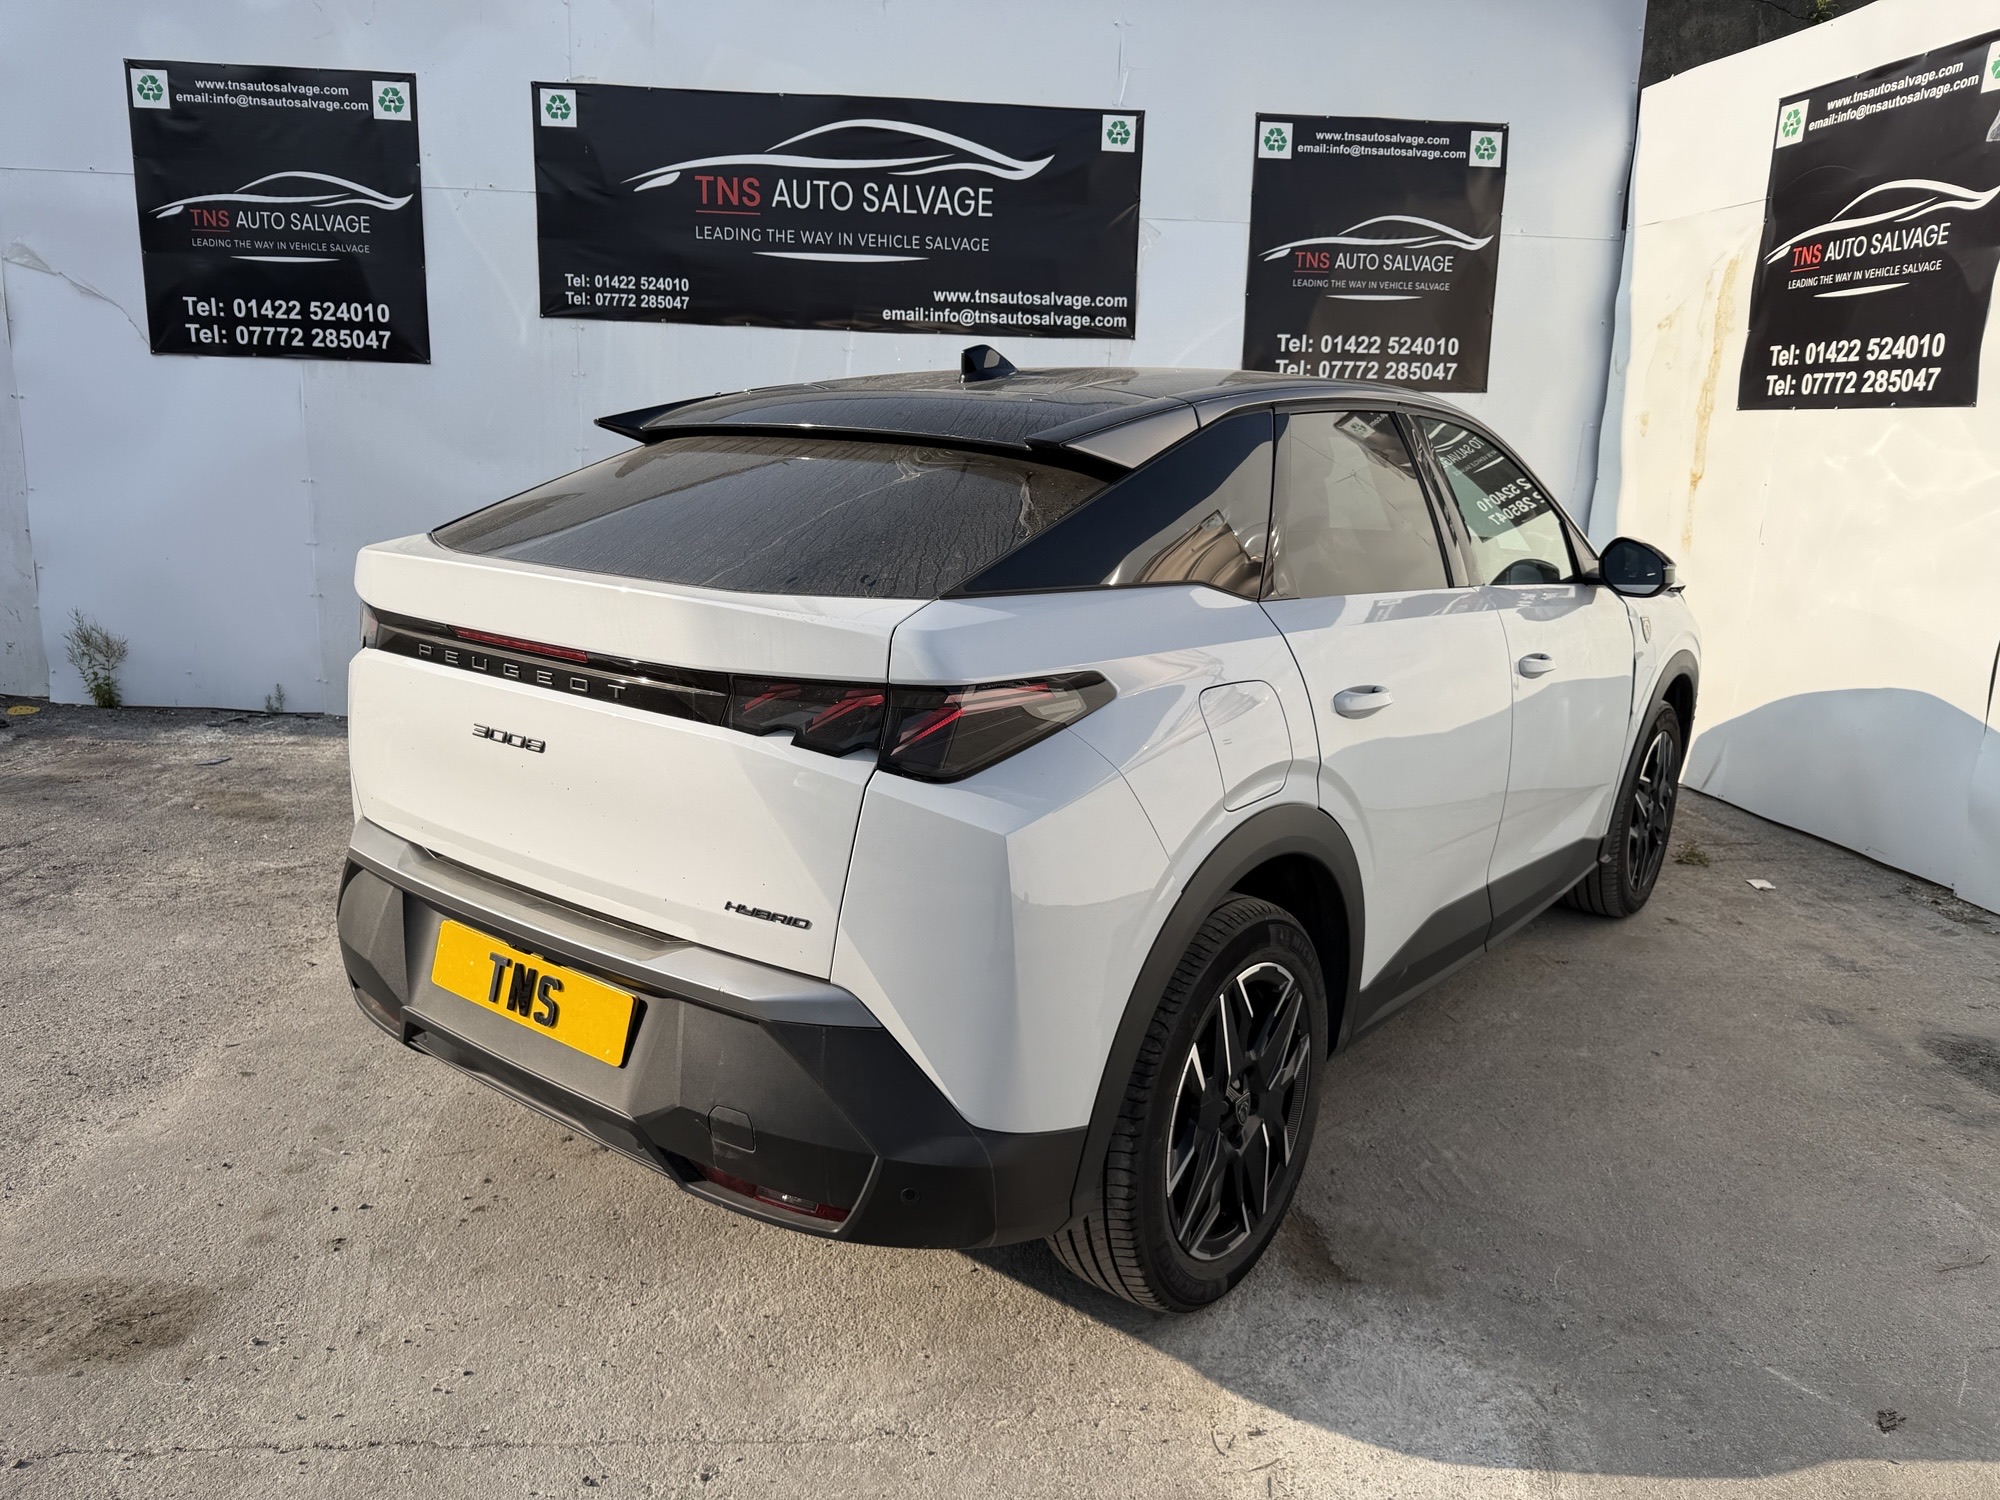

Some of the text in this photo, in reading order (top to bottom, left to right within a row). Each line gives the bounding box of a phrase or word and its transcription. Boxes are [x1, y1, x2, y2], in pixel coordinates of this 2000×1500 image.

[194, 79, 349, 96] www.tnsautosalvage.com
[1827, 61, 1963, 111] www.tnsautosalvage.com
[176, 92, 369, 112] email:info@tnsautosalvage.com
[1808, 73, 1979, 132] email:info@tnsautosalvage.com
[1316, 131, 1450, 145] www.tnsautosalvage.com
[1297, 144, 1466, 159] email:info@tnsautosalvage.com
[694, 174, 994, 218] TNS AUTO SALVAGE
[190, 209, 370, 233] TNS AUTO SALVAGE
[192, 238, 369, 253] LEADING THE WAY IN VEHICLE SALVAGE
[695, 226, 990, 252] LEADING THE WAY IN VEHICLE SALVAGE
[1792, 222, 1951, 267] TNS AUTO SALVAGE
[1295, 252, 1453, 272] TNS AUTO SALVAGE
[565, 272, 690, 292] Tel: 01422 524010
[1293, 279, 1450, 291] LEADING THE WAY IN VEHICLE SALVAGE
[1788, 260, 1942, 290] LEADING THE WAY IN VEHICLE SALVAGE
[183, 296, 389, 323] Tel: 01422 524010
[566, 291, 690, 310] Tel: 07772 285047
[934, 288, 1128, 310] www.tnsautosalvage.com
[882, 306, 1128, 329] email:info@tnsautosalvage.com
[185, 324, 391, 349] Tel: 07772 285047
[1277, 334, 1459, 355] Tel: 01422 524010
[1770, 333, 1946, 366] Tel: 01422 524010
[1275, 359, 1457, 381] Tel: 07772 285047
[1766, 367, 1941, 397] Tel: 07772 285047
[419, 642, 627, 700] PEUGEOT
[472, 722, 546, 753] 3008
[725, 900, 813, 930] HYBRID
[488, 951, 564, 1029] TNS
